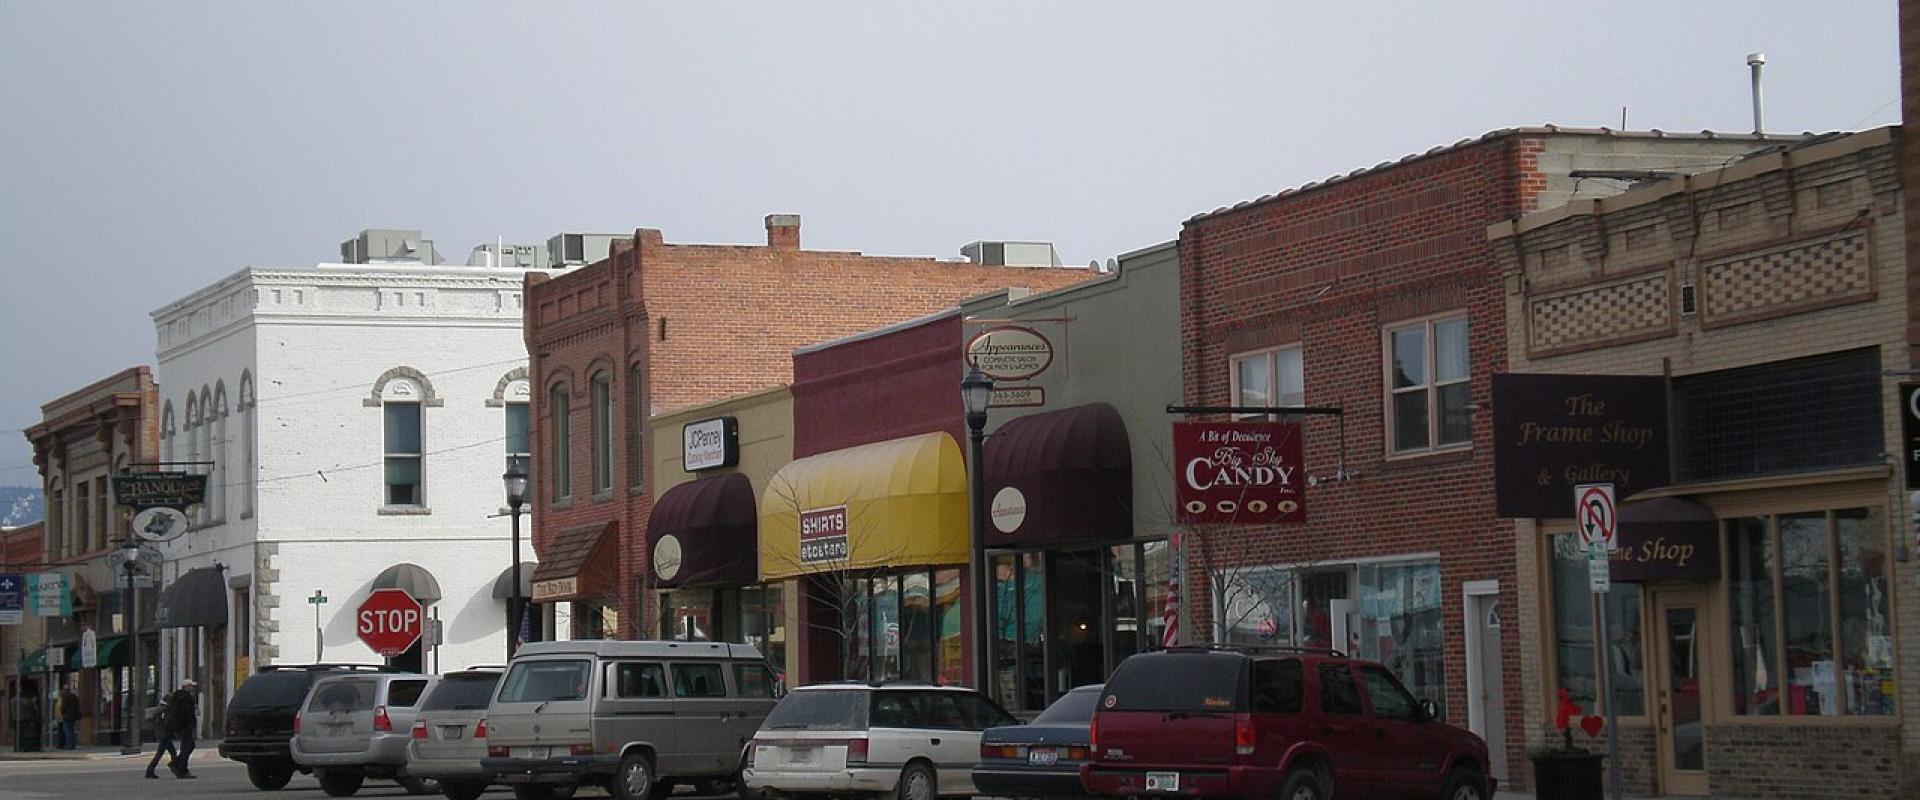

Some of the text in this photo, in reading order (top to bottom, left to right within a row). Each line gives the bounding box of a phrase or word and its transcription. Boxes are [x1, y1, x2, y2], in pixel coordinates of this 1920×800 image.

[972, 335, 1046, 356] Appearances
[1565, 393, 1606, 416] The
[689, 430, 721, 449] JCPenney
[1200, 431, 1206, 441] A
[1208, 430, 1219, 442] Bit
[1222, 430, 1231, 444] of
[1516, 420, 1654, 448] Frame Shop
[1212, 446, 1282, 470] Big Sky
[1186, 457, 1295, 490] CANDY
[1537, 463, 1632, 486] & Gallery
[802, 513, 844, 535] SHIRTS
[1637, 536, 1696, 567] Shop
[360, 609, 418, 634] STOP
